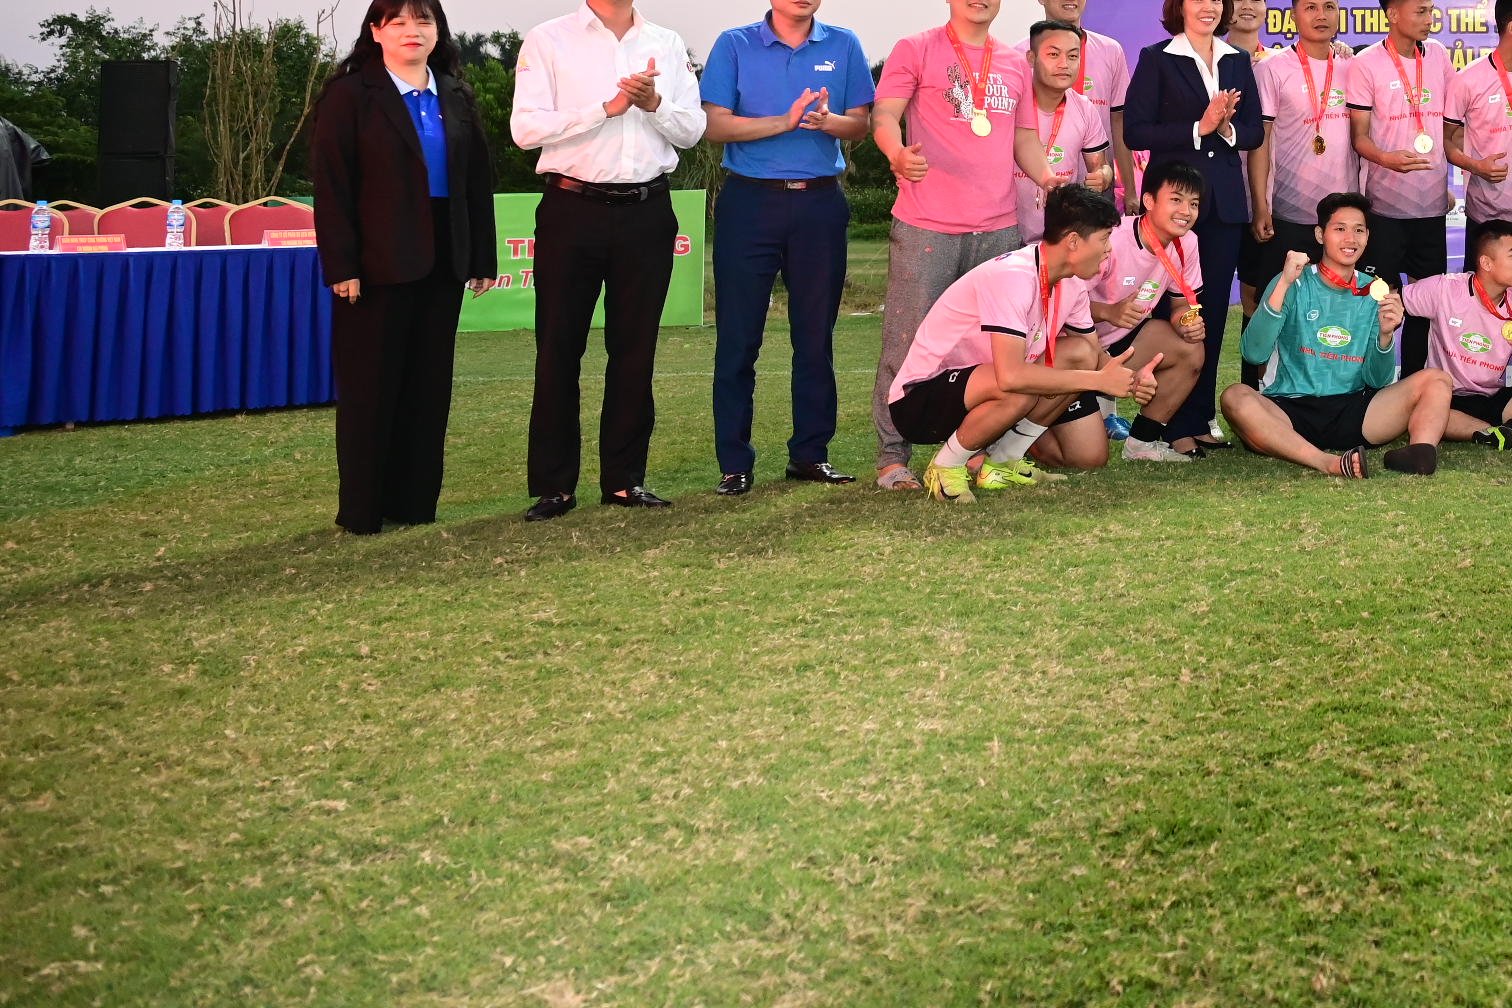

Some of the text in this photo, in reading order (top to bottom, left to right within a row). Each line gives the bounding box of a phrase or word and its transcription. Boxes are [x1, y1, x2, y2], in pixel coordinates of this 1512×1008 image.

[1267, 8, 1298, 38] ĐẠ
[1447, 0, 1488, 33] THỂ
[985, 84, 1009, 98] OUR
